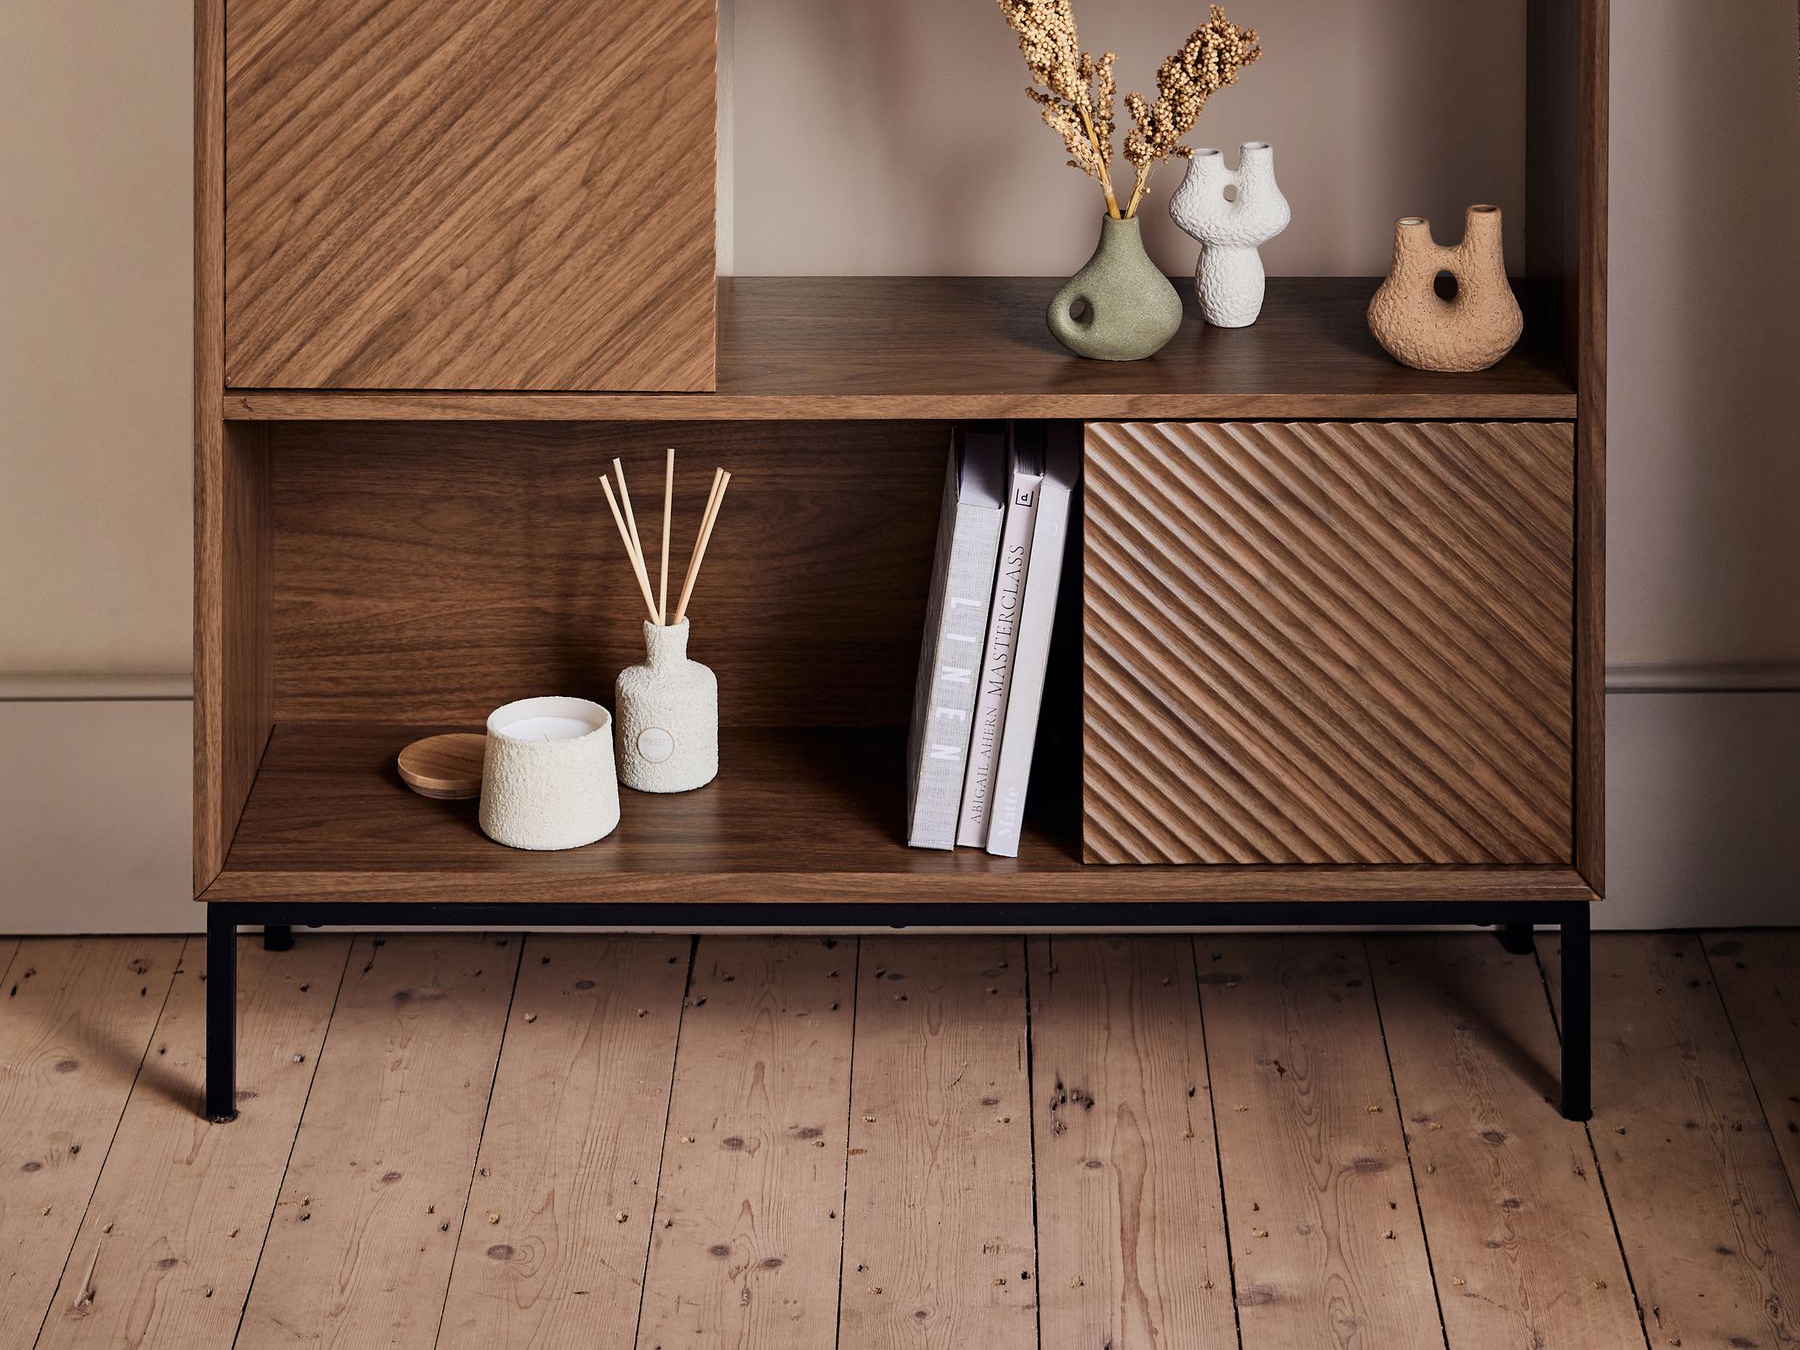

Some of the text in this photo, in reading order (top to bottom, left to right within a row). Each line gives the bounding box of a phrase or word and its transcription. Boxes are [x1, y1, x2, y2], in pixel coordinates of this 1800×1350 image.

[930, 597, 982, 761] LINEN
[970, 544, 1025, 824] ABIGAIL AHERN MASTERCLASS
